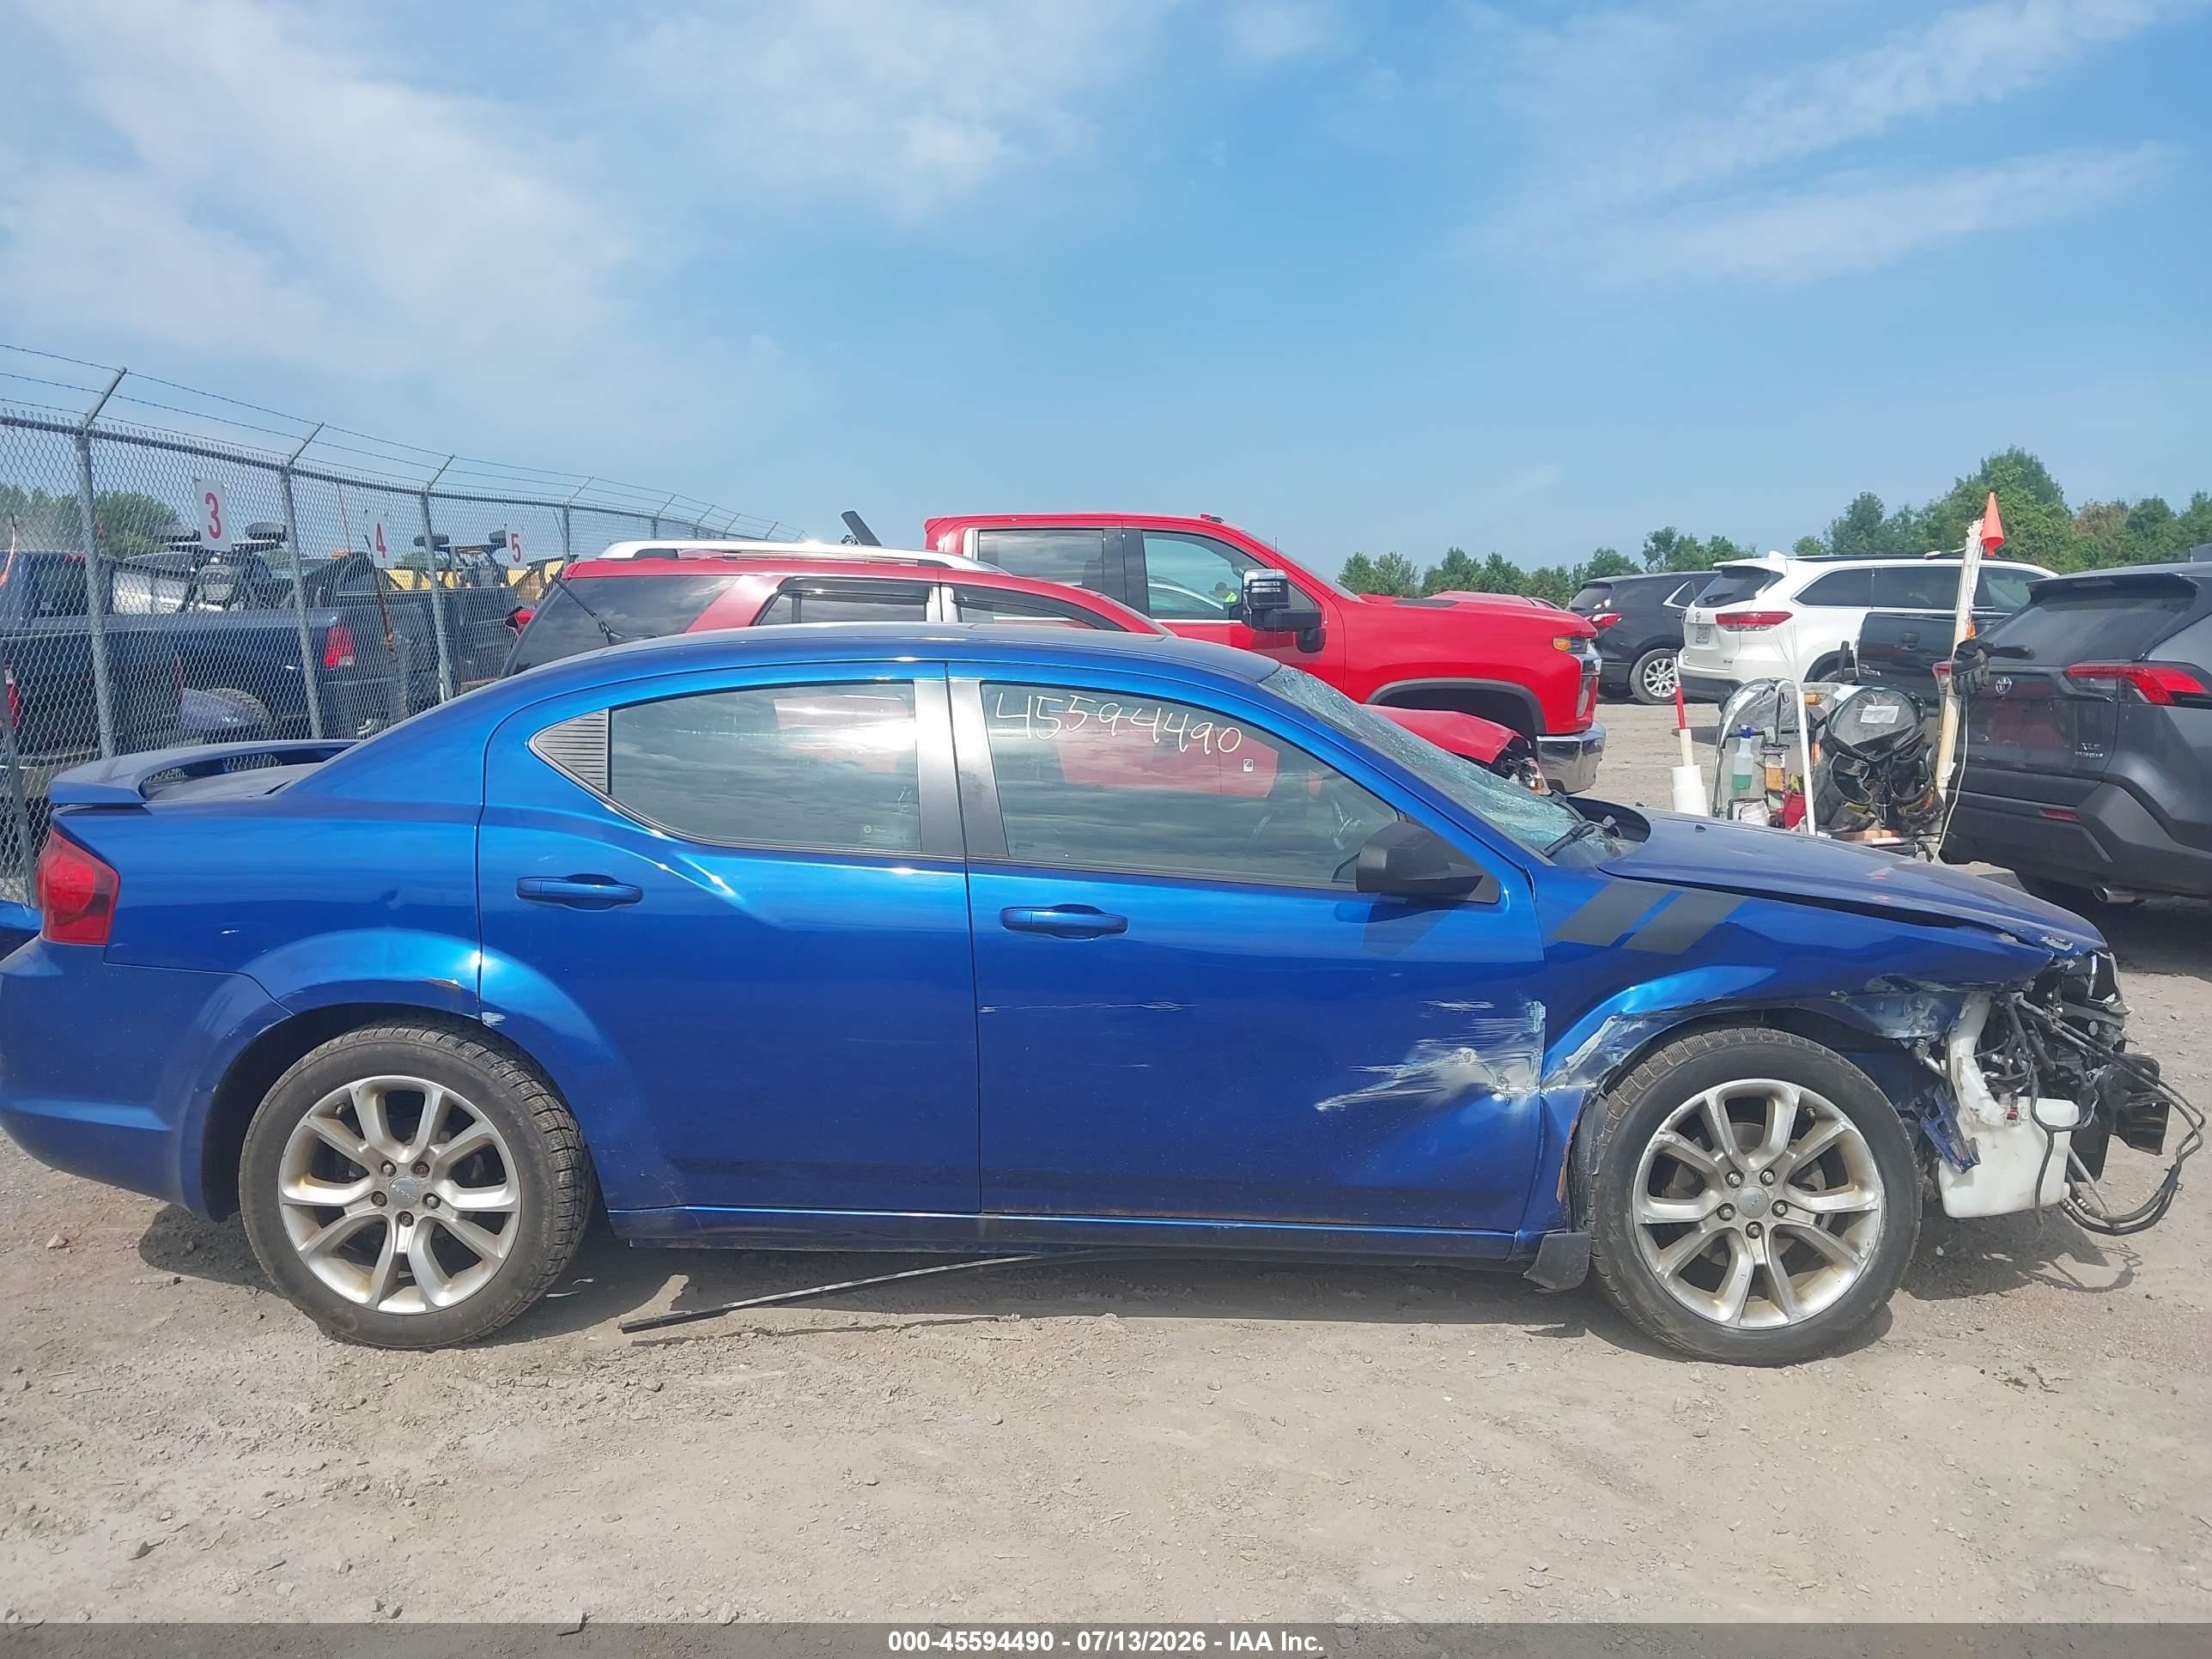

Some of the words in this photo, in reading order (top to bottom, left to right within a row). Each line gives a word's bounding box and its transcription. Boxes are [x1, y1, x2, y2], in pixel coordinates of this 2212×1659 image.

[204, 492, 222, 539] 3
[375, 522, 387, 559] 4
[511, 532, 521, 563] 5
[994, 692, 1243, 756] 45594490
